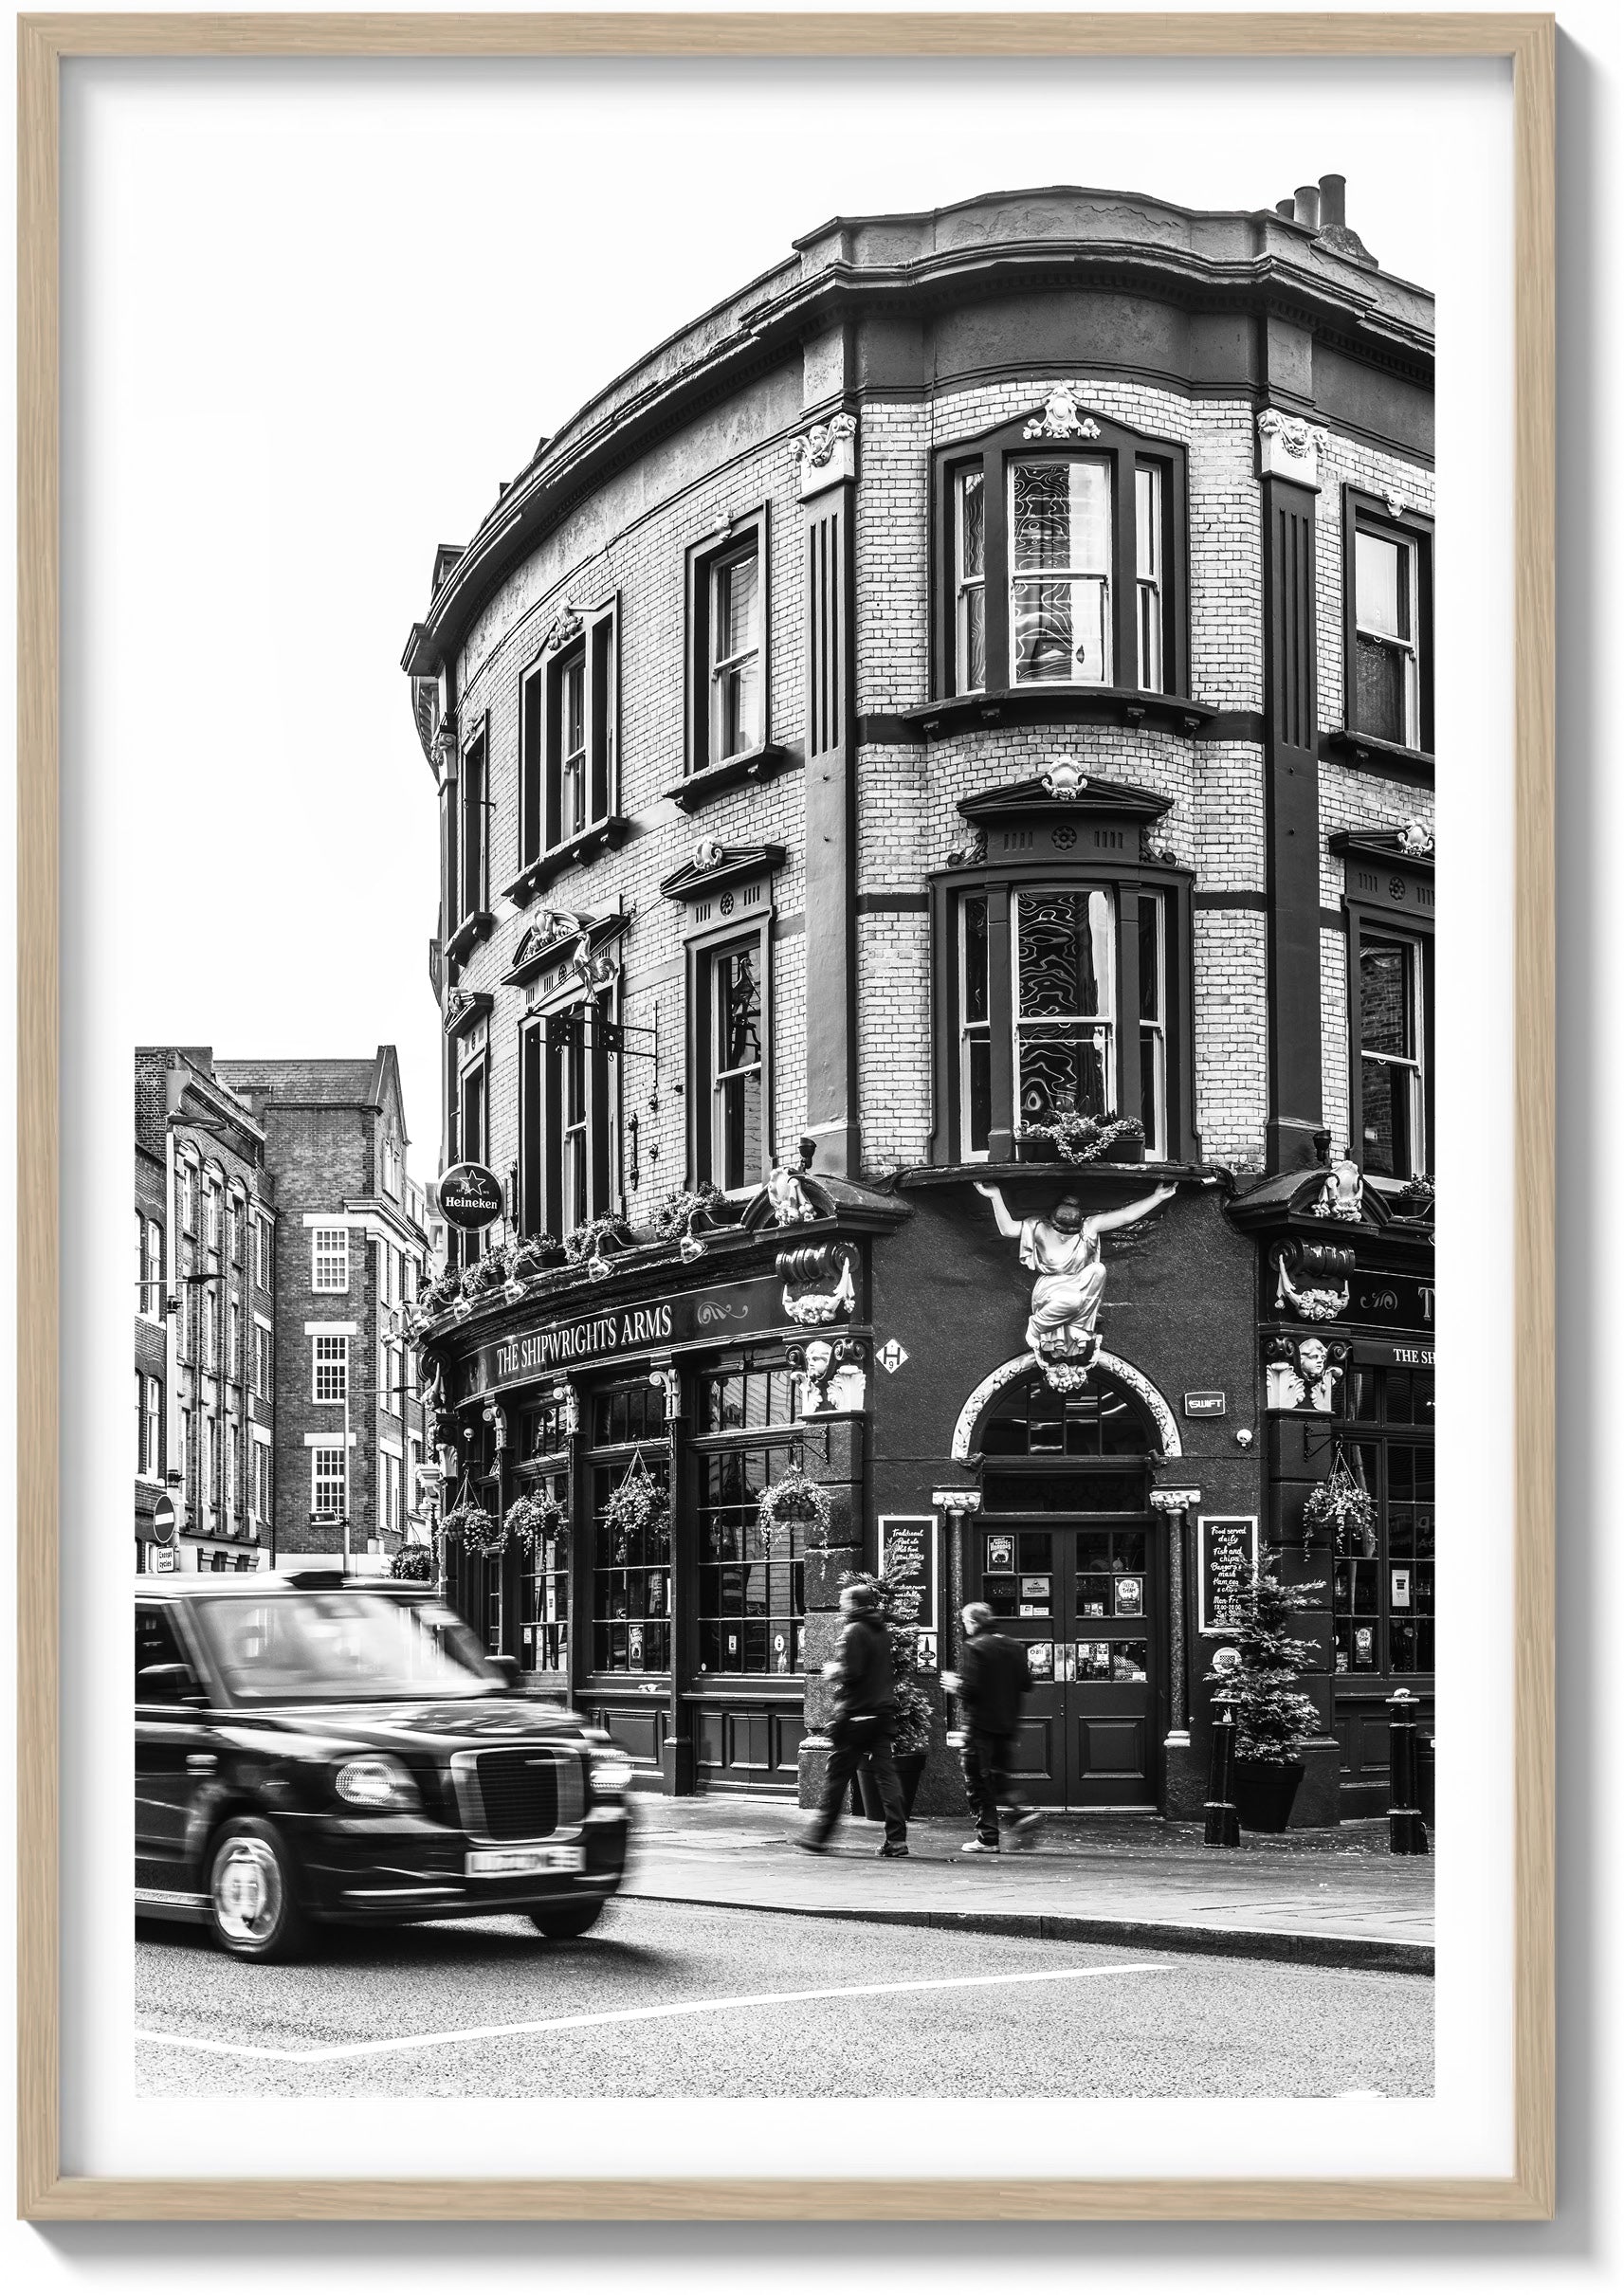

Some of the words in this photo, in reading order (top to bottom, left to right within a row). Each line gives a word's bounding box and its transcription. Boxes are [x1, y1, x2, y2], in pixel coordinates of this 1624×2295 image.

[445, 1196, 498, 1210] Heineken
[496, 1343, 520, 1375] THE
[521, 1317, 617, 1368] SHIPWRIGHTS
[620, 1304, 672, 1345] ARMS
[1393, 1348, 1419, 1363] THE
[1188, 1399, 1223, 1410] SWIFT
[1217, 1534, 1239, 1546] daily
[1228, 1546, 1242, 1555] and
[159, 1561, 172, 1570] cycles
